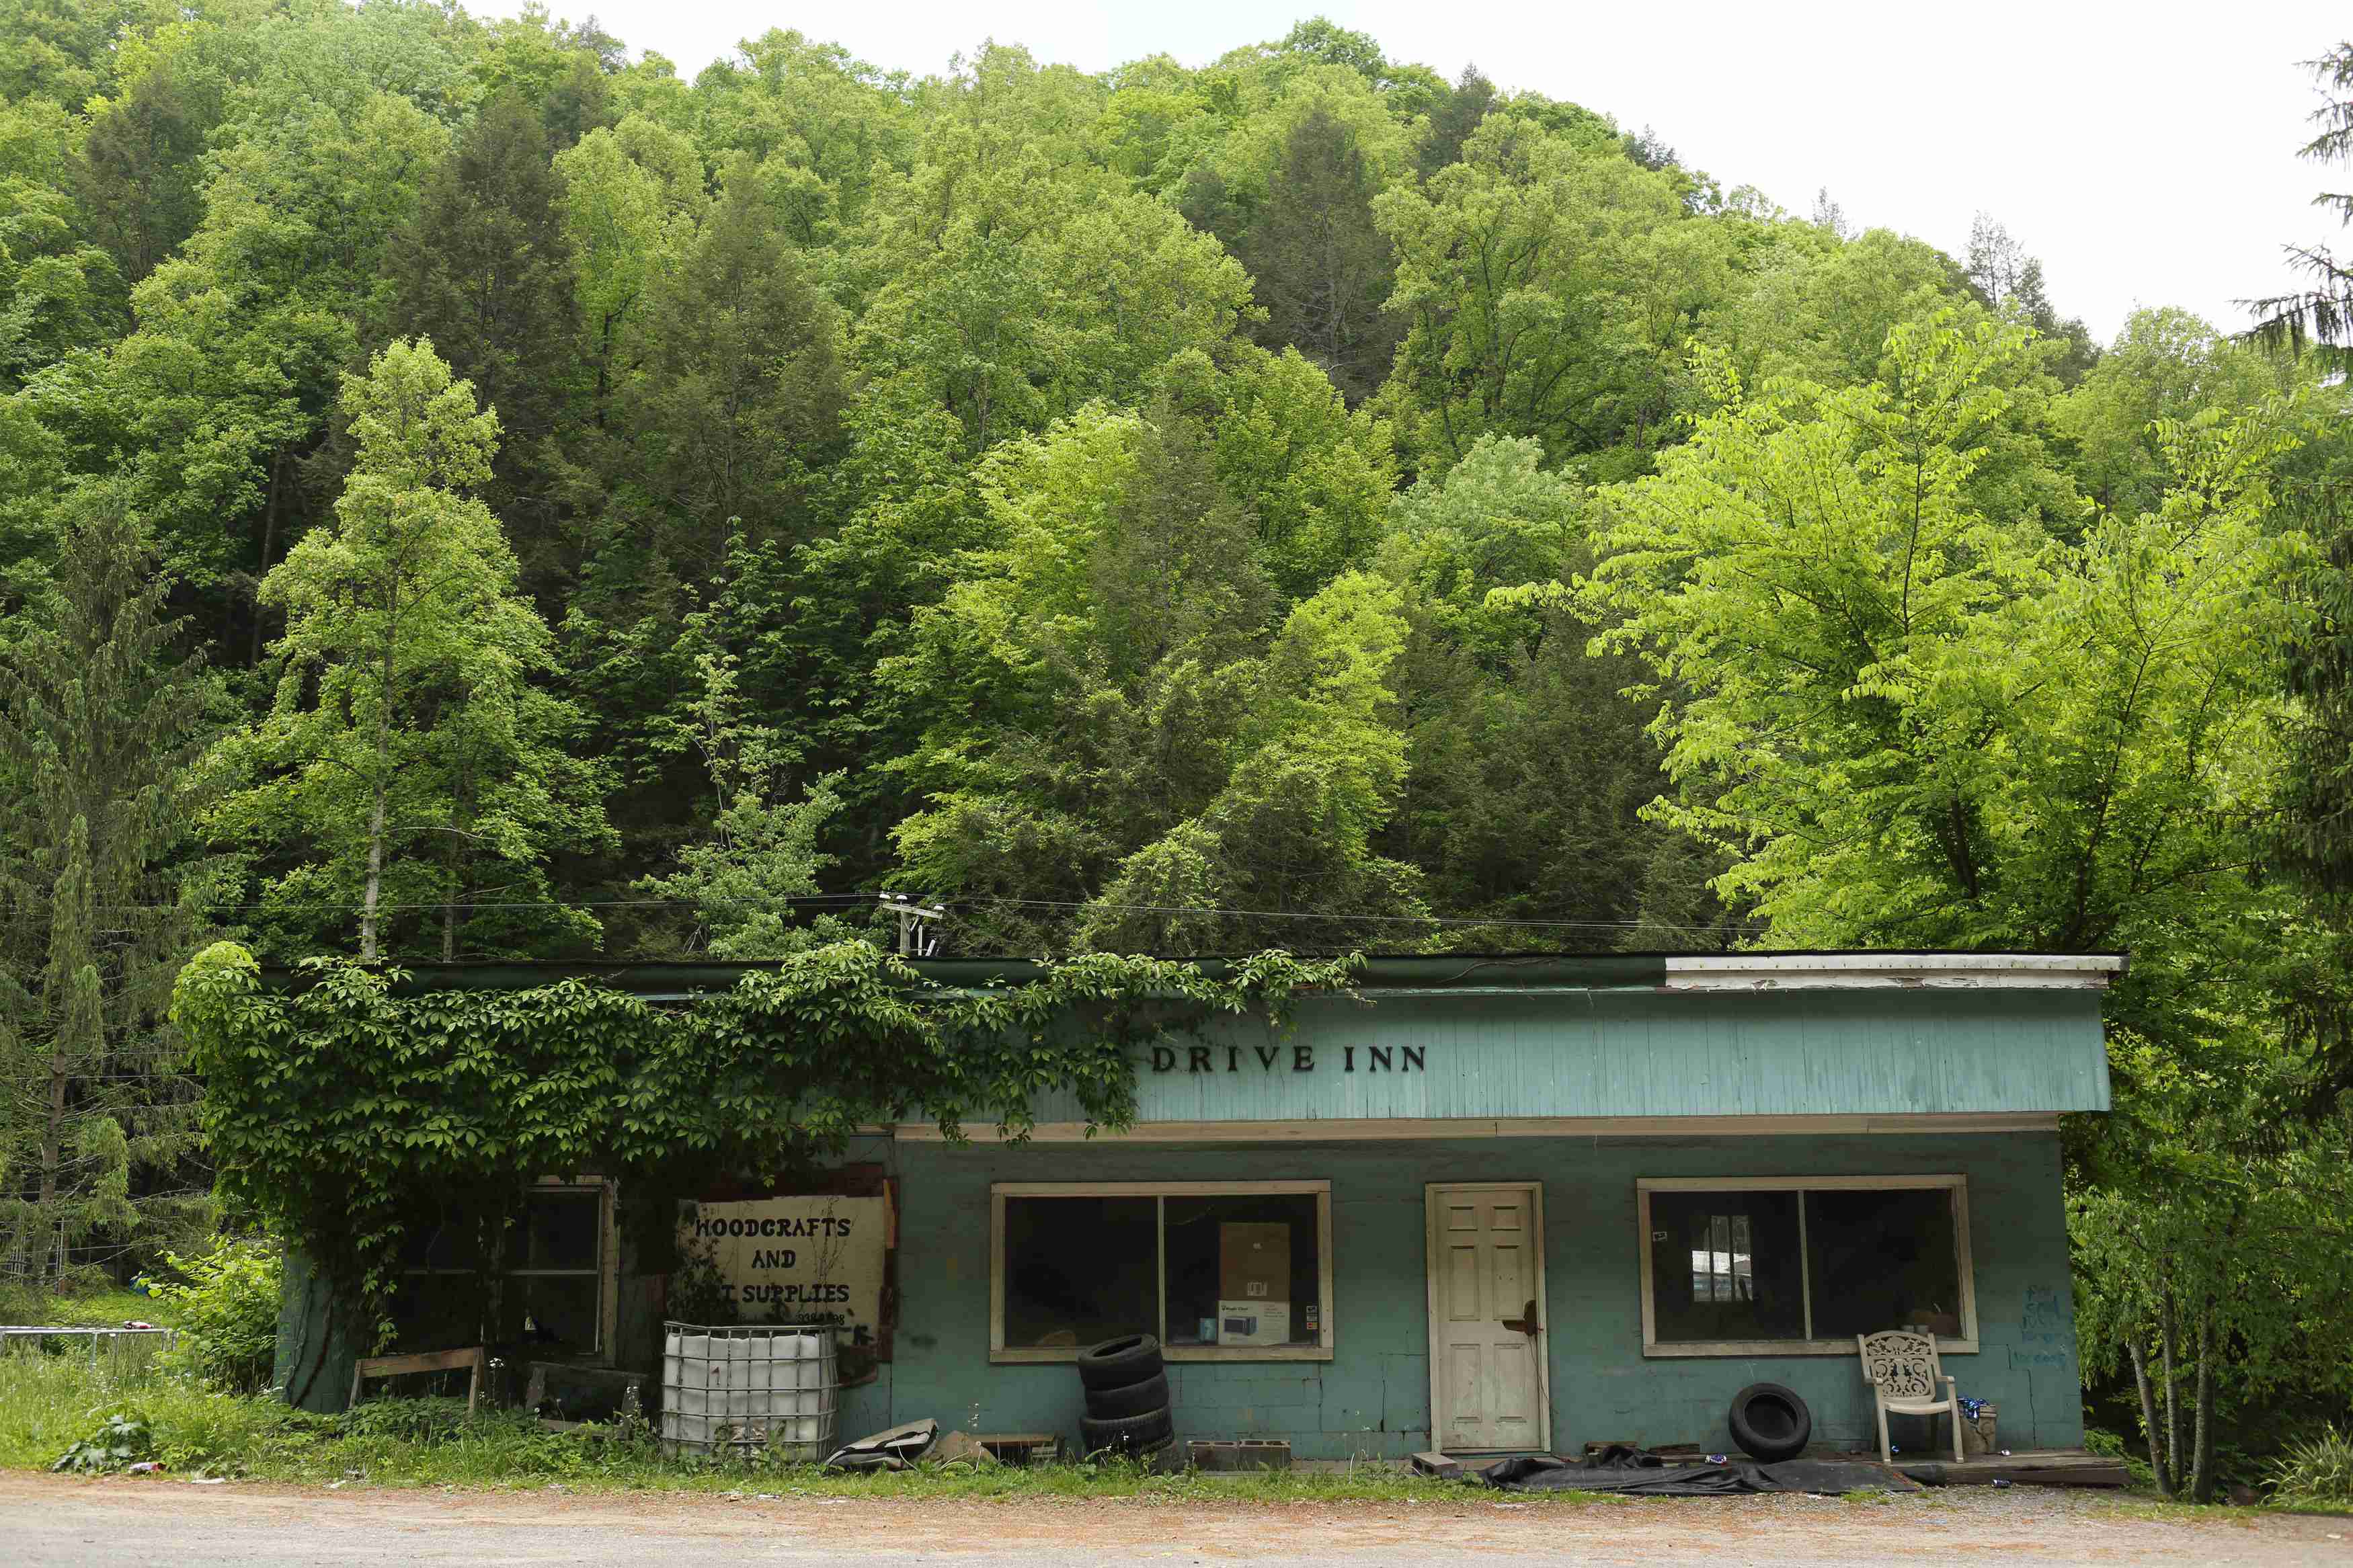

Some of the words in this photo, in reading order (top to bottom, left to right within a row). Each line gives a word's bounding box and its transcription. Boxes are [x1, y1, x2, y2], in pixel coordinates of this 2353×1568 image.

[1152, 1046, 1316, 1072] DRIVE
[1345, 1046, 1426, 1072] INN
[695, 1218, 850, 1237] WOODCRAFTS
[752, 1249, 796, 1269] AND
[742, 1284, 850, 1303] SUPPLIES
